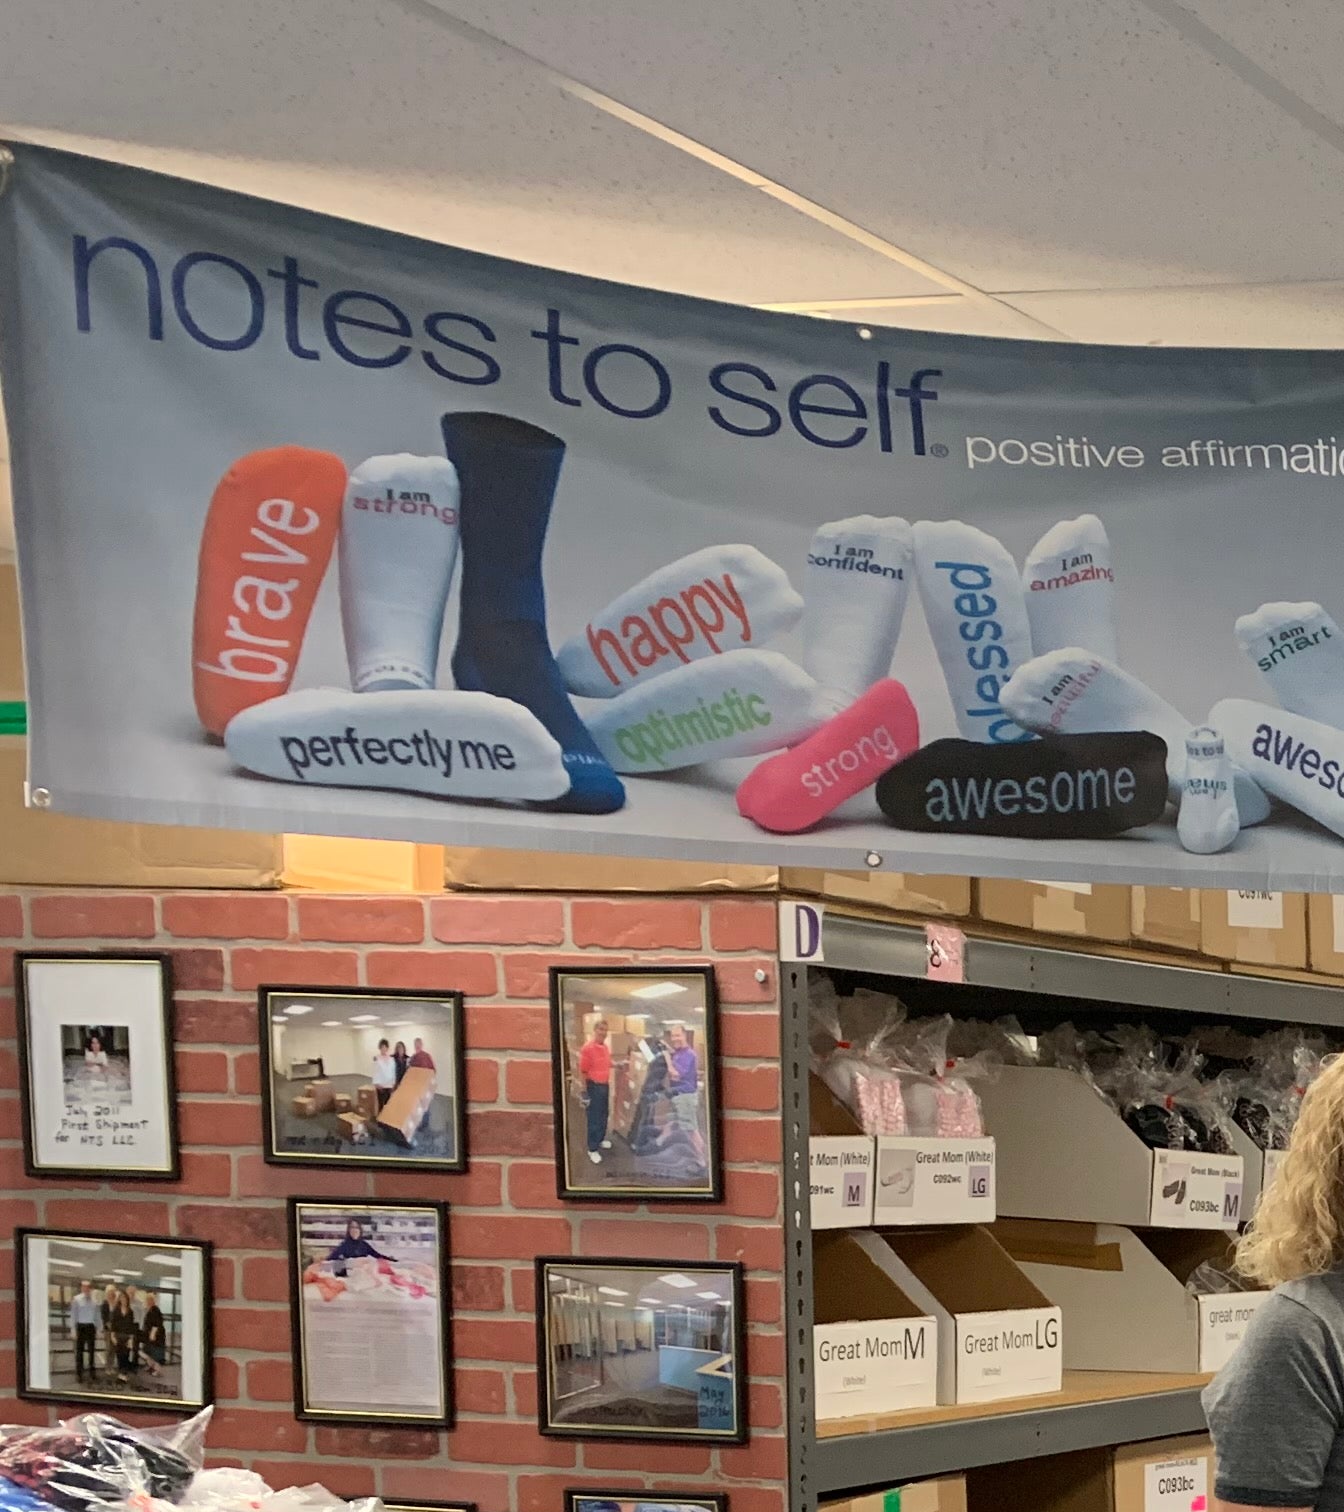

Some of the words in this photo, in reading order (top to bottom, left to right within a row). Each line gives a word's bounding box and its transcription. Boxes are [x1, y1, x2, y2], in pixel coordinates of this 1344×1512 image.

[72, 233, 501, 387] notes
[532, 308, 672, 419] to
[965, 435, 1145, 470] positive
[353, 496, 459, 525] strong
[399, 490, 431, 502] am
[849, 546, 874, 559] am
[1070, 552, 1093, 567] am
[195, 496, 320, 685] brave
[586, 571, 752, 686] happy
[1257, 625, 1332, 672] smart
[614, 686, 772, 765] optimistic
[459, 737, 517, 771] me
[800, 723, 901, 798] strong
[925, 764, 1137, 823] awesome
[796, 904, 820, 958] D
[916, 1151, 940, 1164] Great
[942, 1151, 963, 1164] Mom
[810, 1184, 834, 1195] 091wc
[848, 1185, 860, 1202] M
[972, 1178, 986, 1195] LG
[1223, 1194, 1239, 1217] M
[819, 1338, 860, 1362] Great
[865, 1337, 903, 1358] Mom
[903, 1326, 925, 1360] M
[964, 1334, 999, 1354] Great
[1001, 1330, 1033, 1350] Mom
[1034, 1318, 1058, 1350] LG
[1158, 1476, 1195, 1495] C093bc
